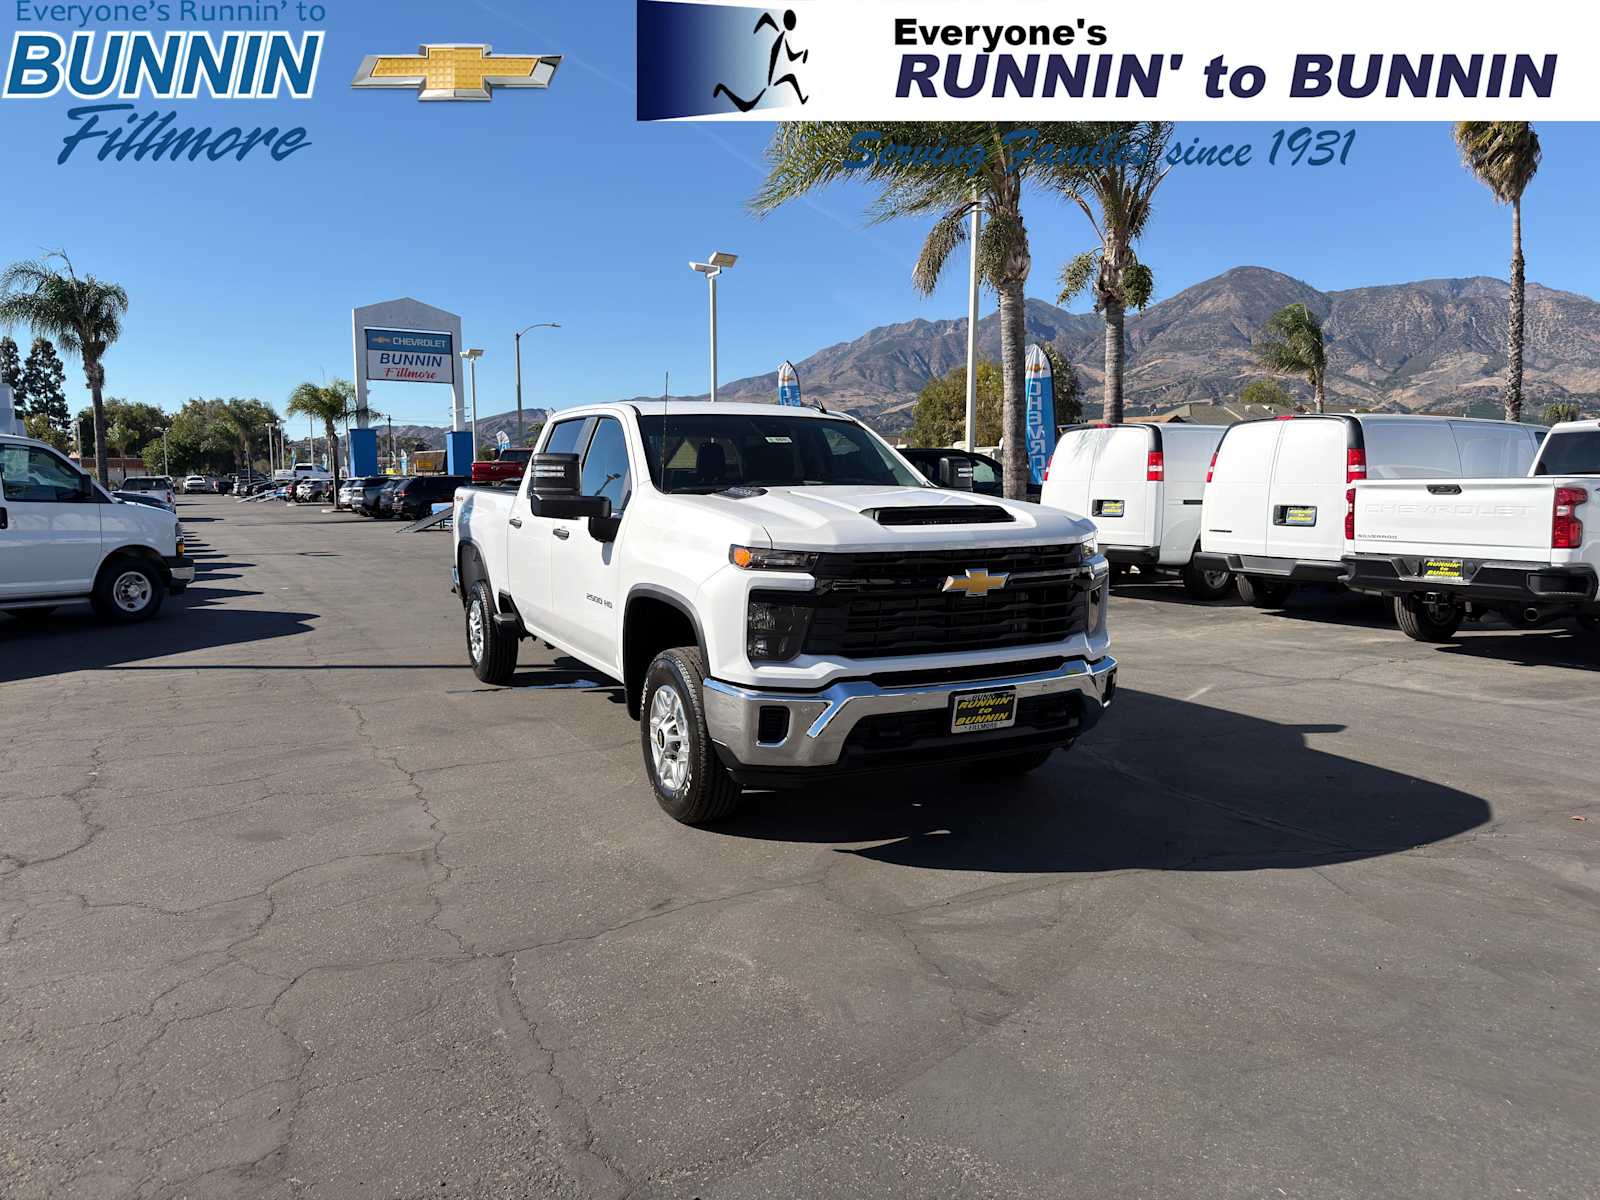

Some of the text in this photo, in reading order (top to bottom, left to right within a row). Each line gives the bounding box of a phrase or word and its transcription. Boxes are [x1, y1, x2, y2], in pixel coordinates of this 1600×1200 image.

[392, 336, 447, 349] CHEVROLET
[380, 352, 443, 368] BUNNIN
[384, 367, 438, 380] Fillmore
[955, 711, 1009, 726] BUNNIN
